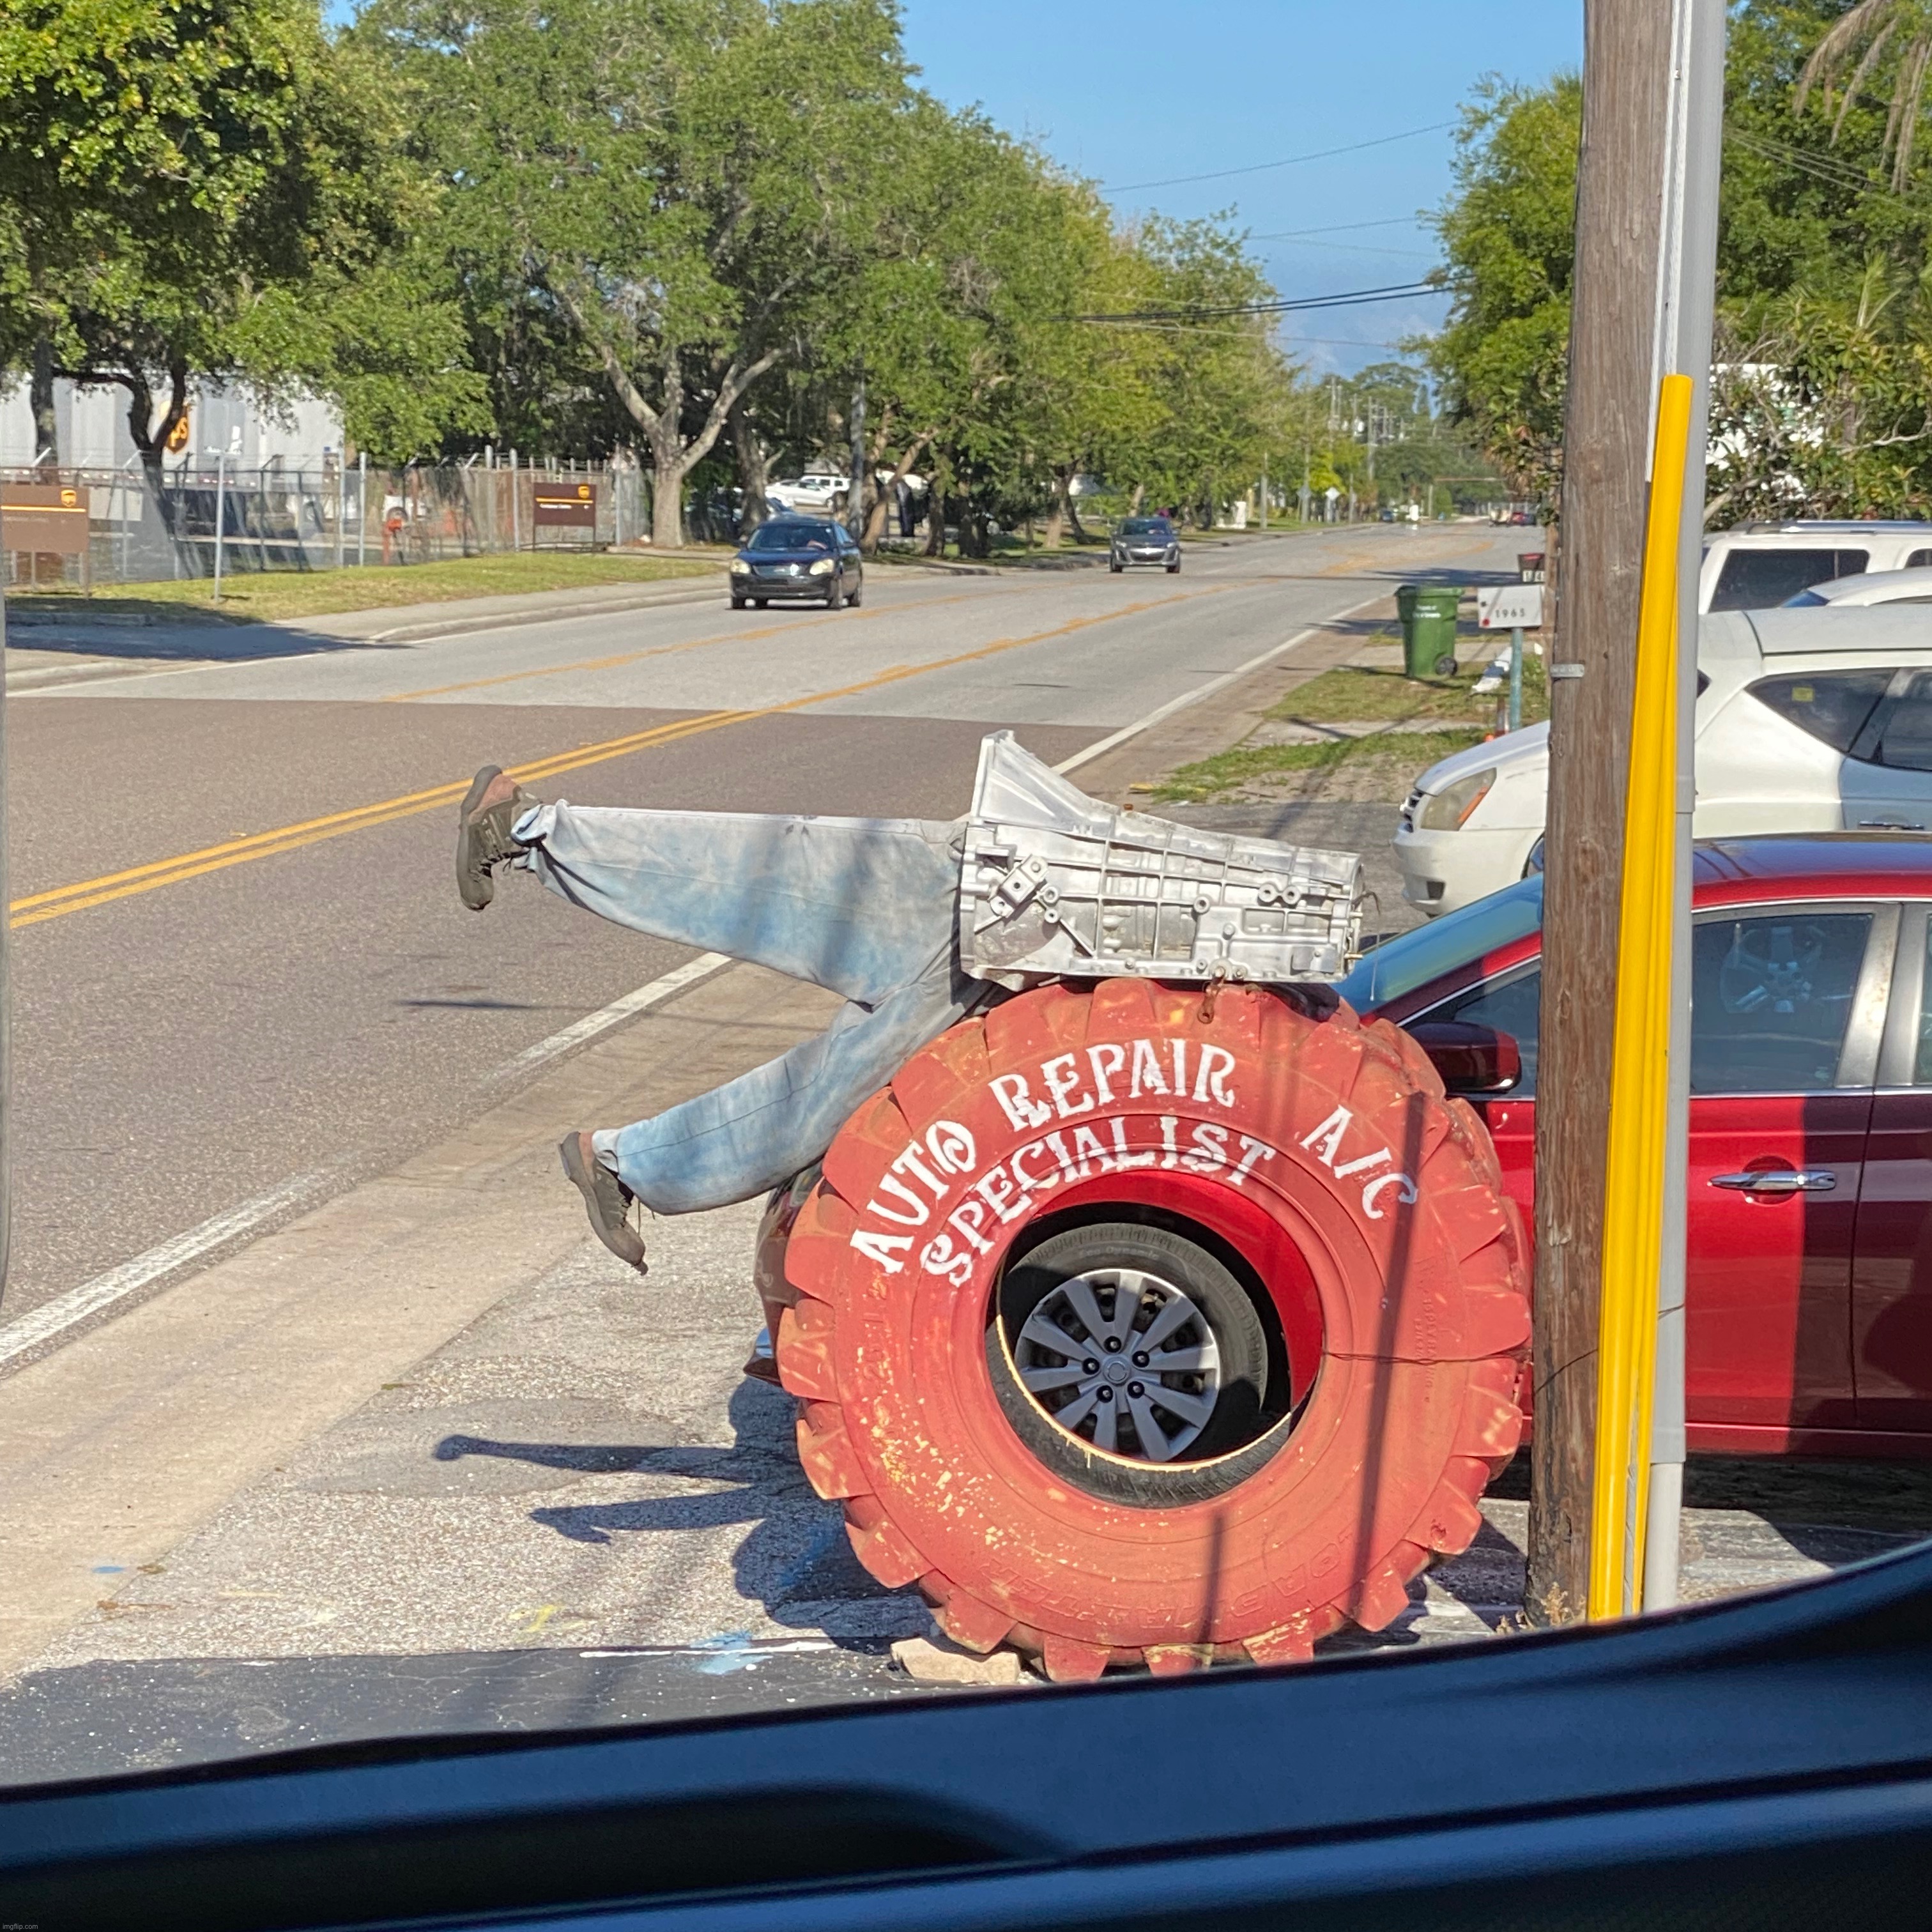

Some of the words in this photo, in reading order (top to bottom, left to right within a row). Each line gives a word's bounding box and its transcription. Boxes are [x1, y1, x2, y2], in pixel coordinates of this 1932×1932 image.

[850, 1120, 976, 1273] AUTO
[988, 1038, 1235, 1131] REPAIR
[1299, 1104, 1418, 1219] A/C
[920, 1115, 1276, 1287] SPECIALIST
